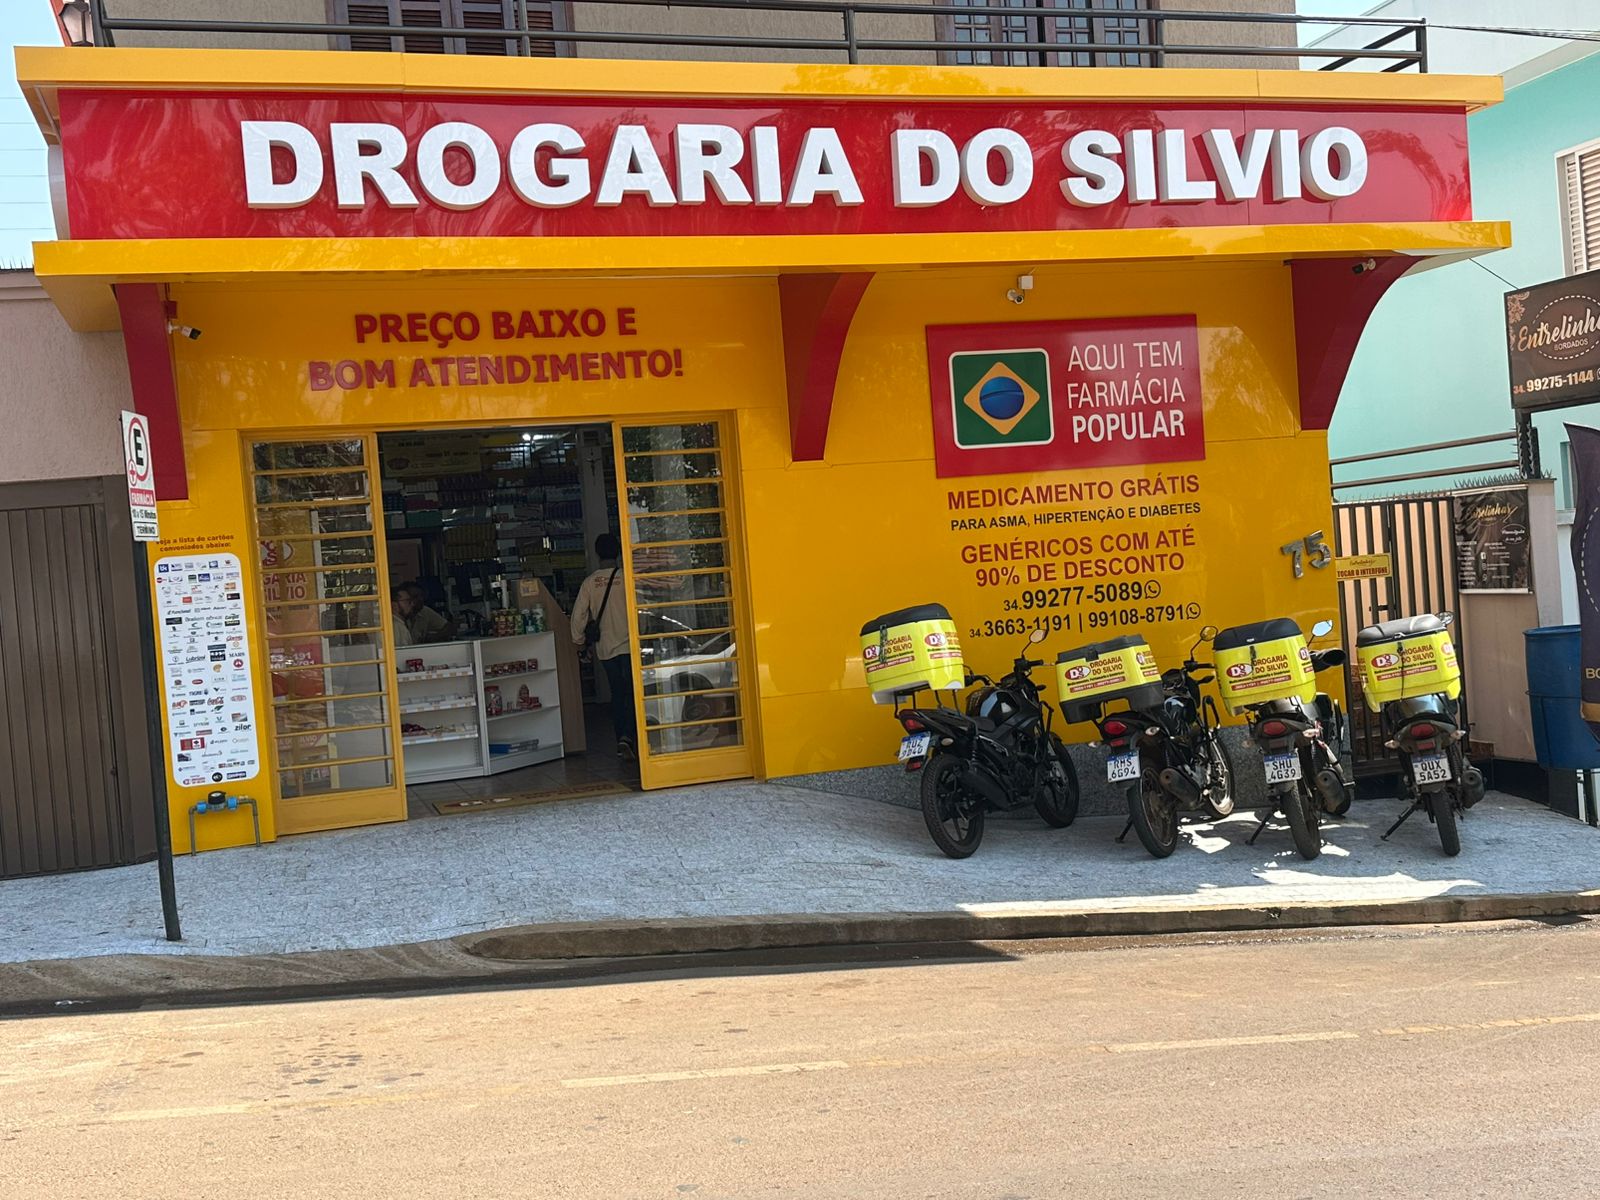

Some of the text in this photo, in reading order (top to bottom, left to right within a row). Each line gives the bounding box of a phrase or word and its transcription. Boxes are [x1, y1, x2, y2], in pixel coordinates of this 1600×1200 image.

[241, 120, 1369, 209] DROGARIA DO SILVIO
[354, 307, 638, 349] PREÇO BAIXO E
[1554, 338, 1589, 351] BORDADOS
[1067, 340, 1184, 372] AQUI TEM
[308, 348, 684, 391] BOM ATENDIMENTO!
[1067, 372, 1186, 409] FARMÁCIA
[1072, 408, 1186, 443] POPULAR
[133, 428, 144, 467] E
[947, 472, 1201, 511] MEDICAMENTO GRÁTIS
[951, 502, 1201, 531] PARA ASMA, HIPERTENÇÃO E DIABETES
[961, 524, 1196, 565] GENÉRICOS COM ATÉ
[1280, 530, 1331, 579] 75
[975, 552, 1185, 588] 90% DE DESCONTO
[1336, 569, 1355, 578] TOCAR
[1360, 566, 1388, 576] INTERFONE
[1088, 604, 1184, 629] 99108-8791
[1089, 655, 1123, 669] DROGARIA
[1252, 654, 1288, 667] DROGARIA
[1413, 652, 1435, 662] SILVIO
[1092, 668, 1102, 676] DO
[1102, 664, 1123, 674] SILVIO
[1266, 662, 1289, 672] SILVIO
[1113, 757, 1133, 769] RMS
[1272, 758, 1293, 770] SHU
[1420, 760, 1441, 772] QUX
[1111, 767, 1137, 779] 6G94
[1270, 769, 1297, 780] 4G39
[1419, 770, 1447, 782] 5A52
